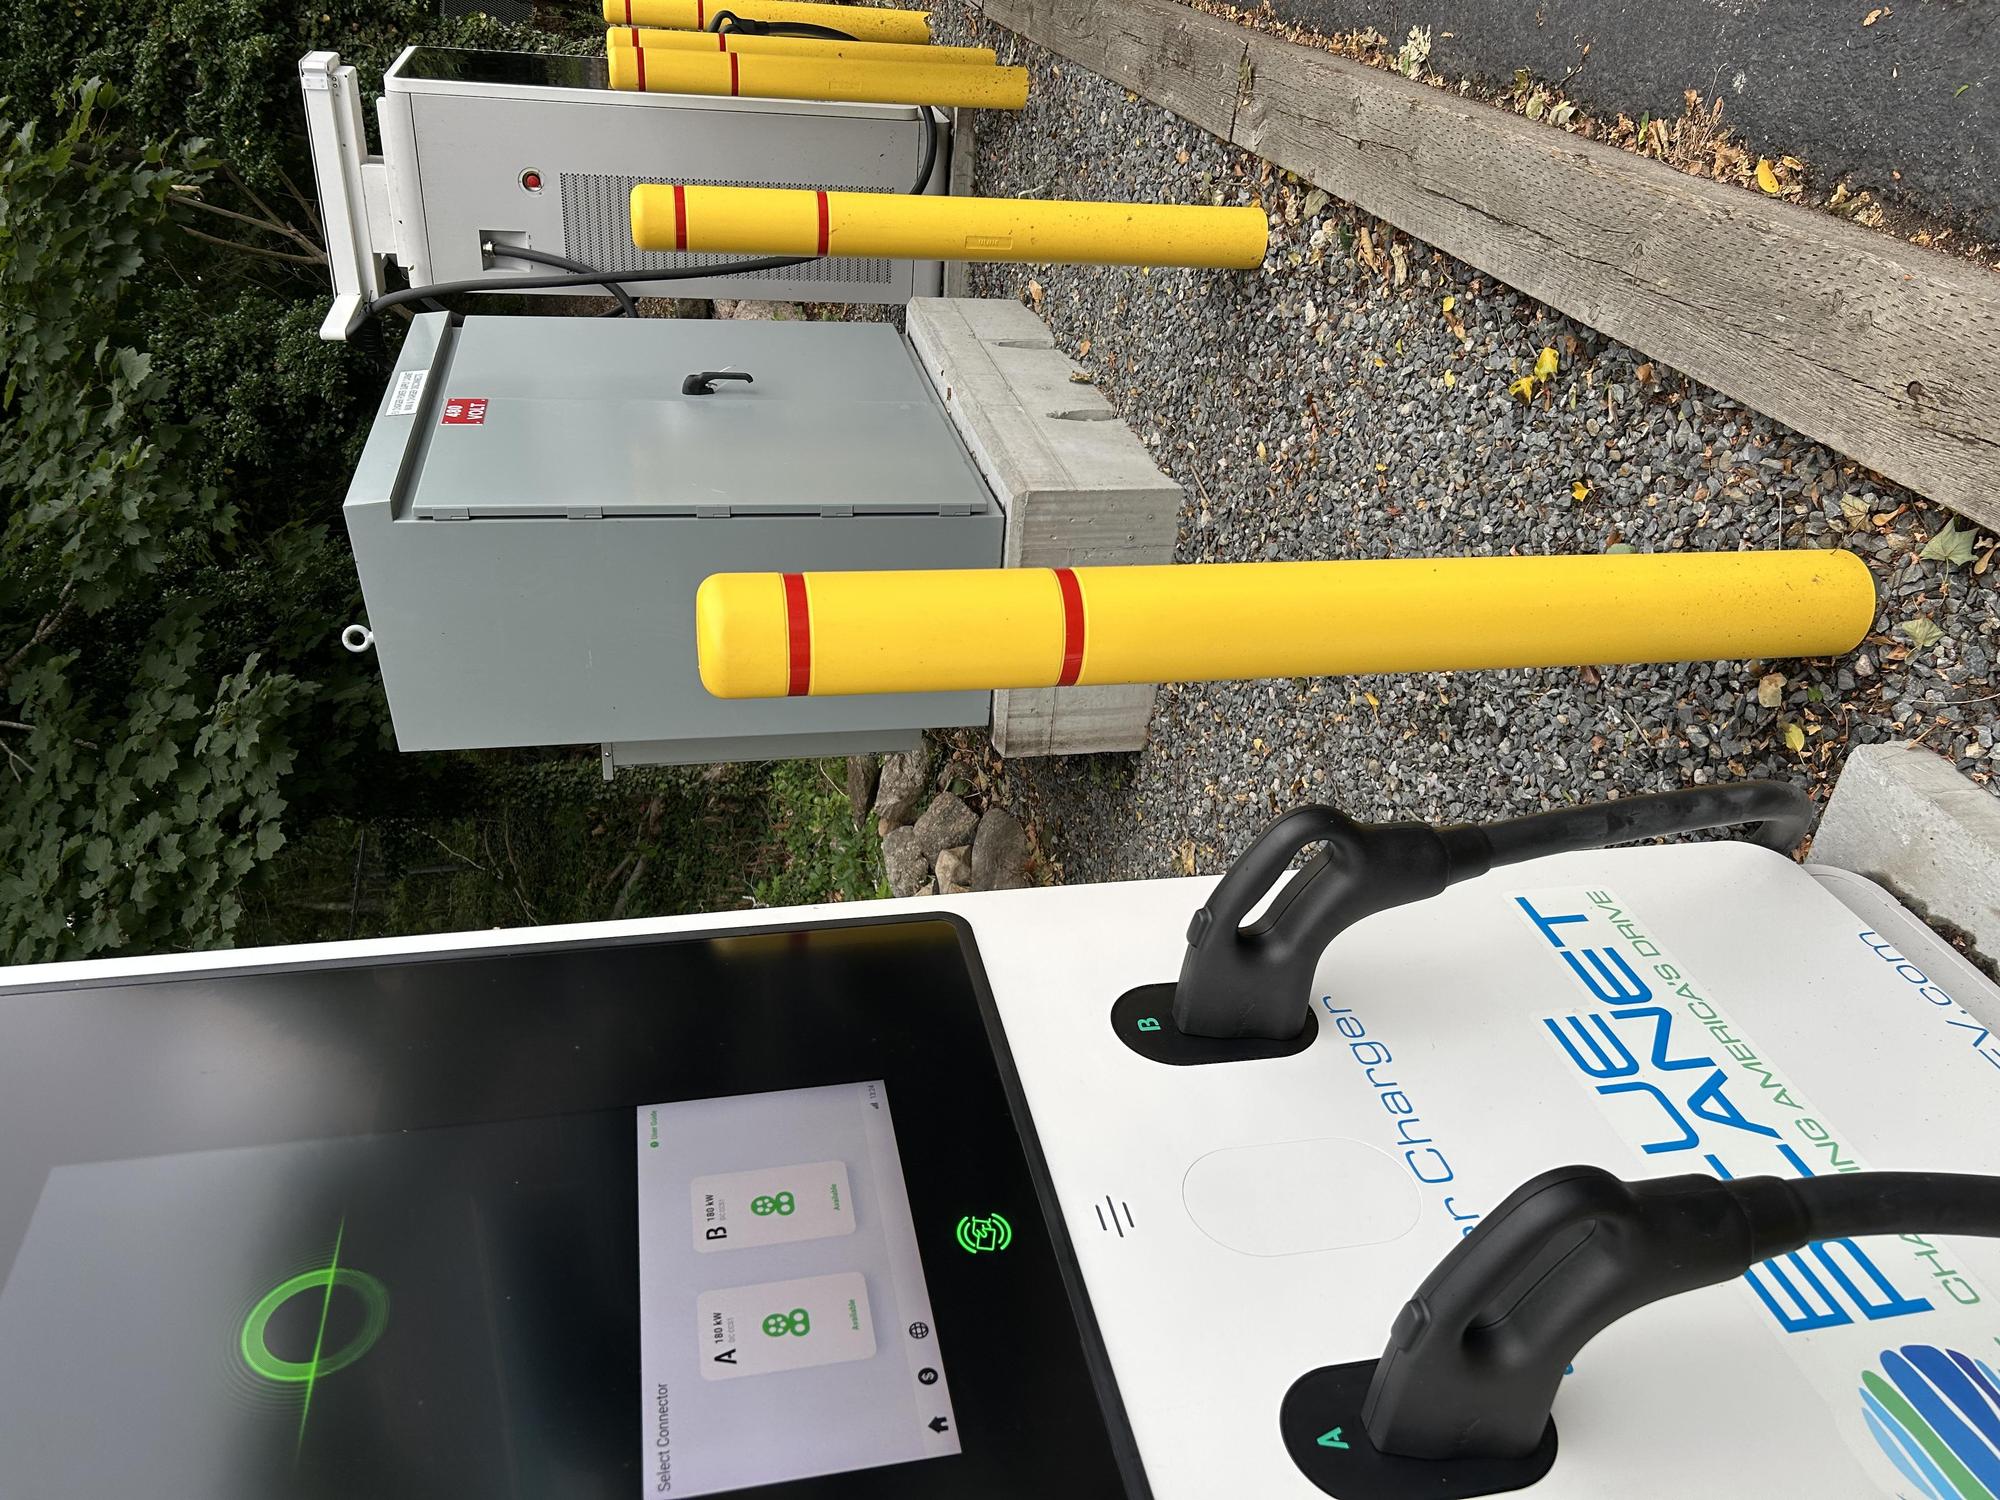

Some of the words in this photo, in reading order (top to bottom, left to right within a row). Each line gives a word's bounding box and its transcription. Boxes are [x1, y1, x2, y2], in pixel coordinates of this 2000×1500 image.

[445, 405, 463, 417] 480
[467, 403, 485, 419] VOLT
[1586, 891, 1658, 957] DRIVE
[1136, 1012, 1161, 1034] B
[1656, 964, 1804, 1111] AMERICA'S
[1321, 994, 1455, 1185] Charger
[705, 1194, 714, 1206] kW
[706, 1207, 715, 1222] 180
[706, 1226, 727, 1240] B
[713, 1312, 722, 1326] kW
[714, 1327, 723, 1344] 180
[714, 1348, 737, 1365] A
[656, 1384, 670, 1447] Connector
[1316, 1426, 1350, 1451] A
[657, 1450, 671, 1493] Select
